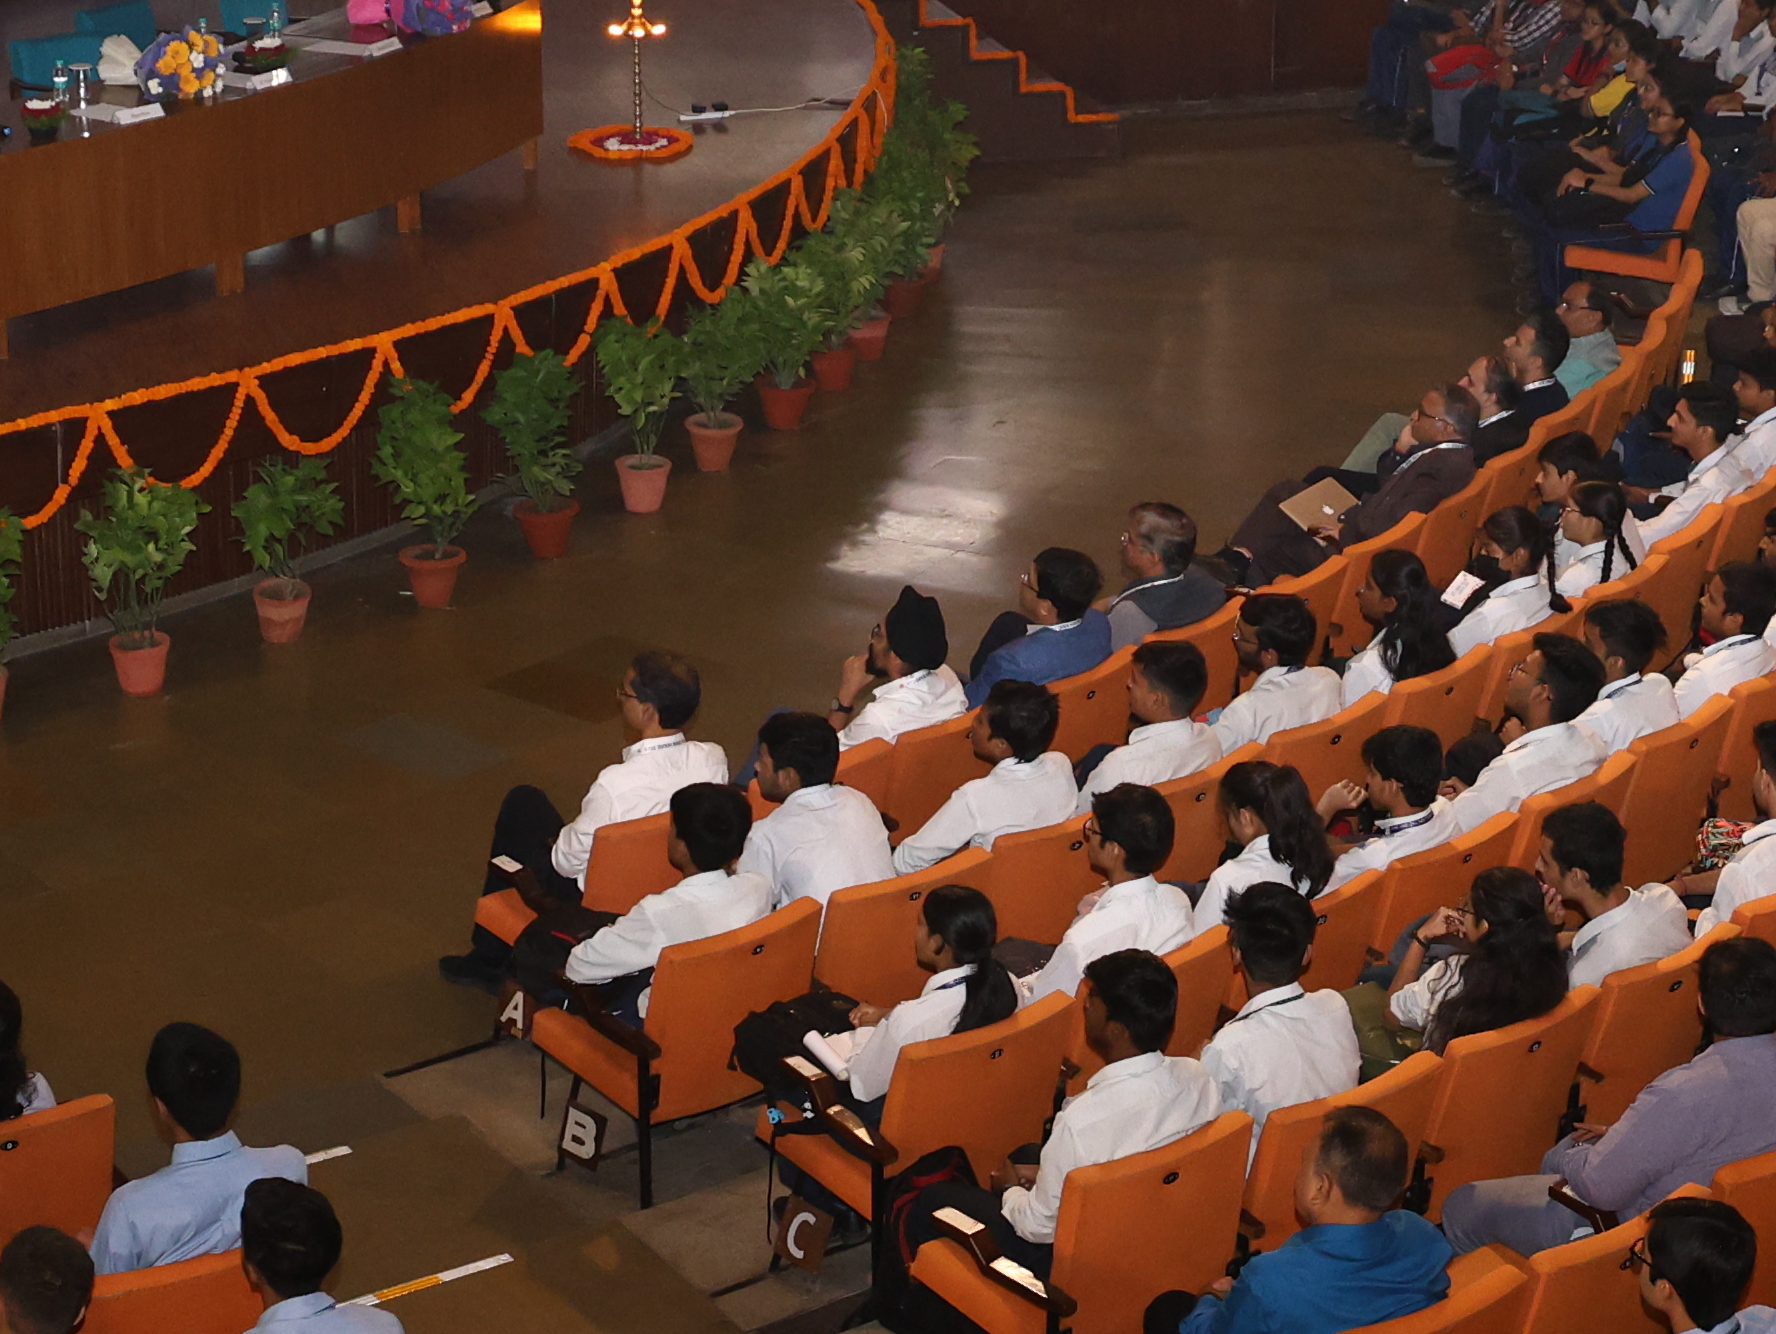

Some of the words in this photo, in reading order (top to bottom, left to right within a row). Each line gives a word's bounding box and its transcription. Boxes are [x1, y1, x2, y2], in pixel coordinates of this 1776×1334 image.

[499, 991, 526, 1023] A
[563, 1108, 596, 1160] B
[786, 1211, 816, 1260] C
